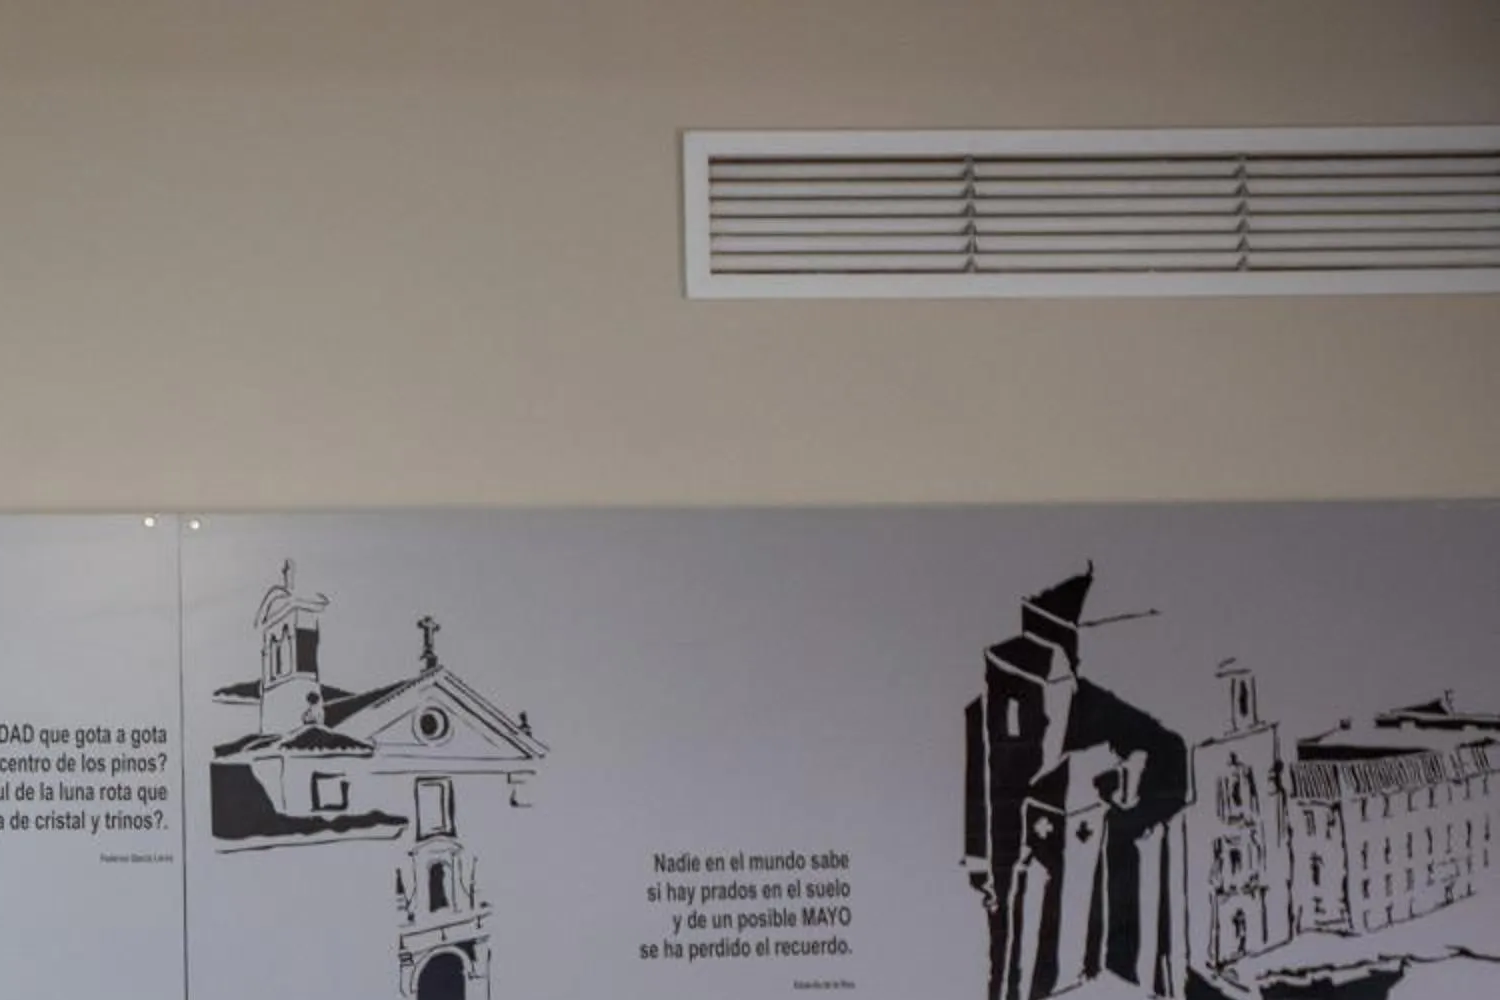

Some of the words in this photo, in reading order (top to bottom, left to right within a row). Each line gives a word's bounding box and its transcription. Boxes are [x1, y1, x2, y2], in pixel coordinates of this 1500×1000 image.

[40, 728, 70, 748] que
[76, 726, 111, 748] gota
[117, 728, 125, 744] a
[131, 726, 167, 748] gota
[0, 755, 51, 772] centro
[56, 753, 76, 772] de
[82, 753, 106, 772] los
[111, 753, 167, 776] pinos?
[15, 782, 34, 801] de
[40, 782, 54, 801] la
[60, 782, 94, 801] luna
[100, 783, 132, 801] rota
[137, 785, 167, 805] que
[10, 810, 29, 830] de
[35, 810, 85, 830] cristal
[91, 814, 100, 834] y
[654, 853, 700, 873] Nadie
[706, 856, 724, 872] en
[730, 852, 744, 871] el
[749, 851, 805, 871] mundo
[811, 850, 849, 869] sabe
[647, 882, 661, 902] si
[667, 882, 695, 905] hay
[701, 880, 757, 904] prados
[762, 883, 782, 899] en
[787, 880, 800, 898] el
[806, 879, 850, 898] suelo
[673, 914, 681, 935] y
[688, 910, 707, 929] de
[712, 913, 732, 928] un
[738, 908, 796, 931] posible
[802, 906, 851, 926] MAYO
[640, 944, 658, 959] se
[664, 939, 683, 958] ha
[689, 938, 750, 962] perdido
[756, 937, 770, 956] el
[775, 936, 852, 956] recuerdo.
